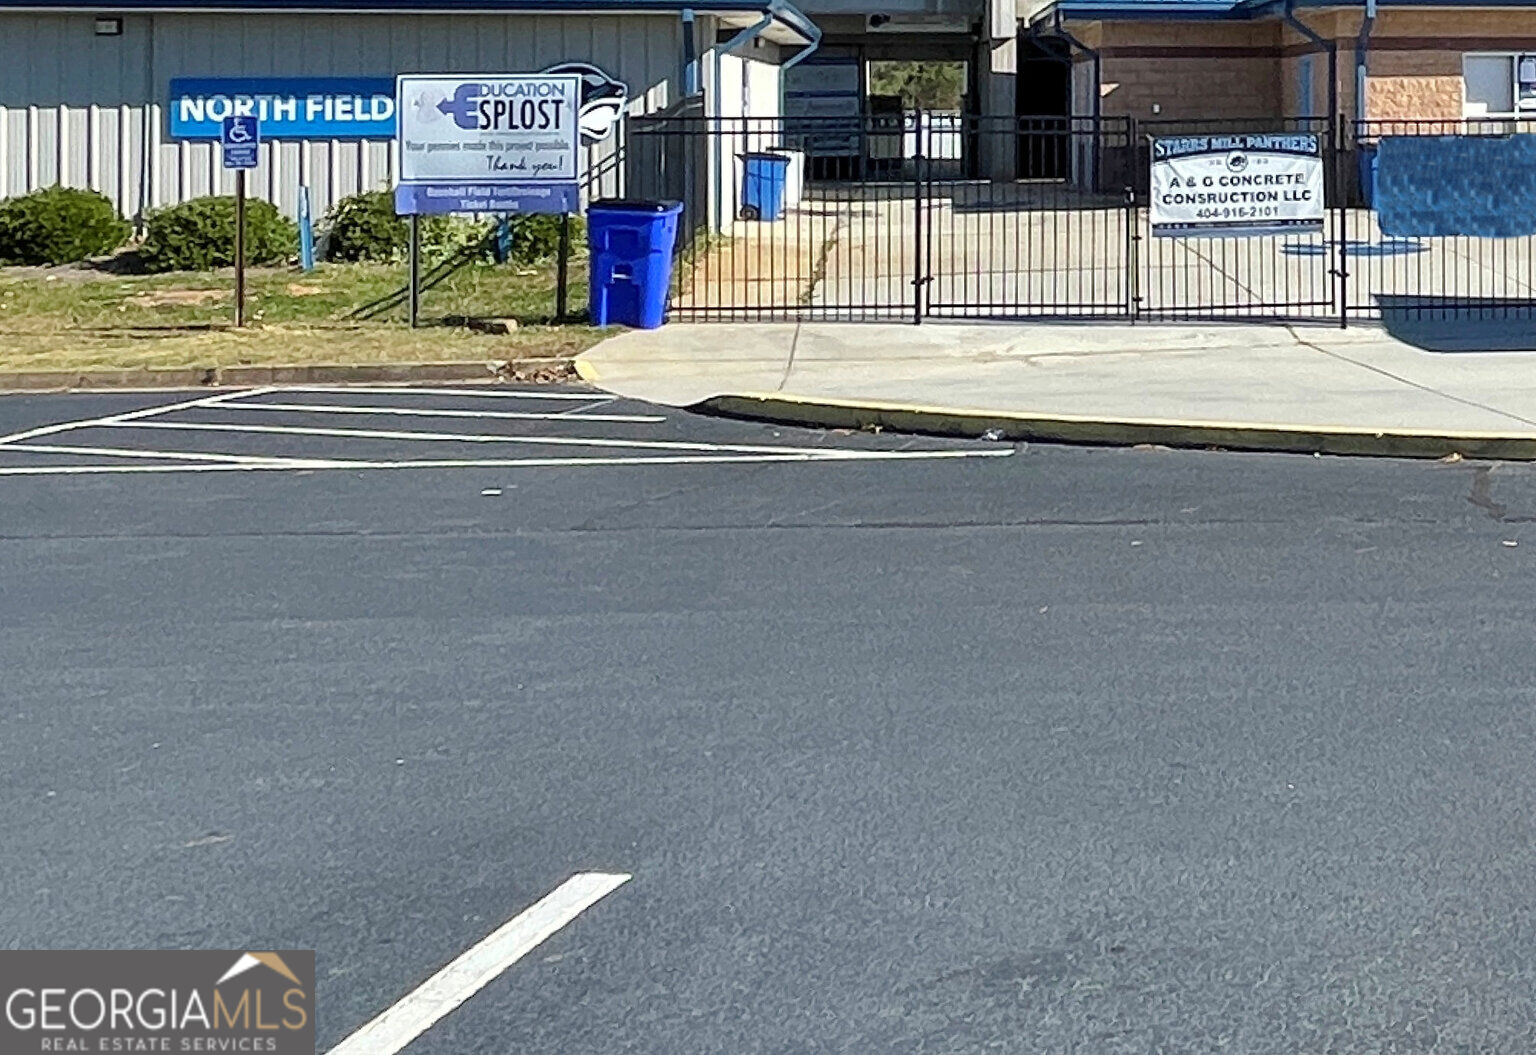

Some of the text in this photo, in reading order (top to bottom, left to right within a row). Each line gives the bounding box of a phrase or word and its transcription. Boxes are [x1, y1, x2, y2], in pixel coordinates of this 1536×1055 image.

[179, 94, 395, 122] NORTH FIELD
[479, 99, 565, 131] SPLOST
[1211, 136, 1244, 150] MILL
[1246, 134, 1318, 153] PANTHERS
[486, 155, 528, 172] Thank
[1169, 177, 1181, 189] A
[1186, 176, 1197, 188] &
[1219, 173, 1306, 187] CONCRETE
[1283, 189, 1312, 202] LLC
